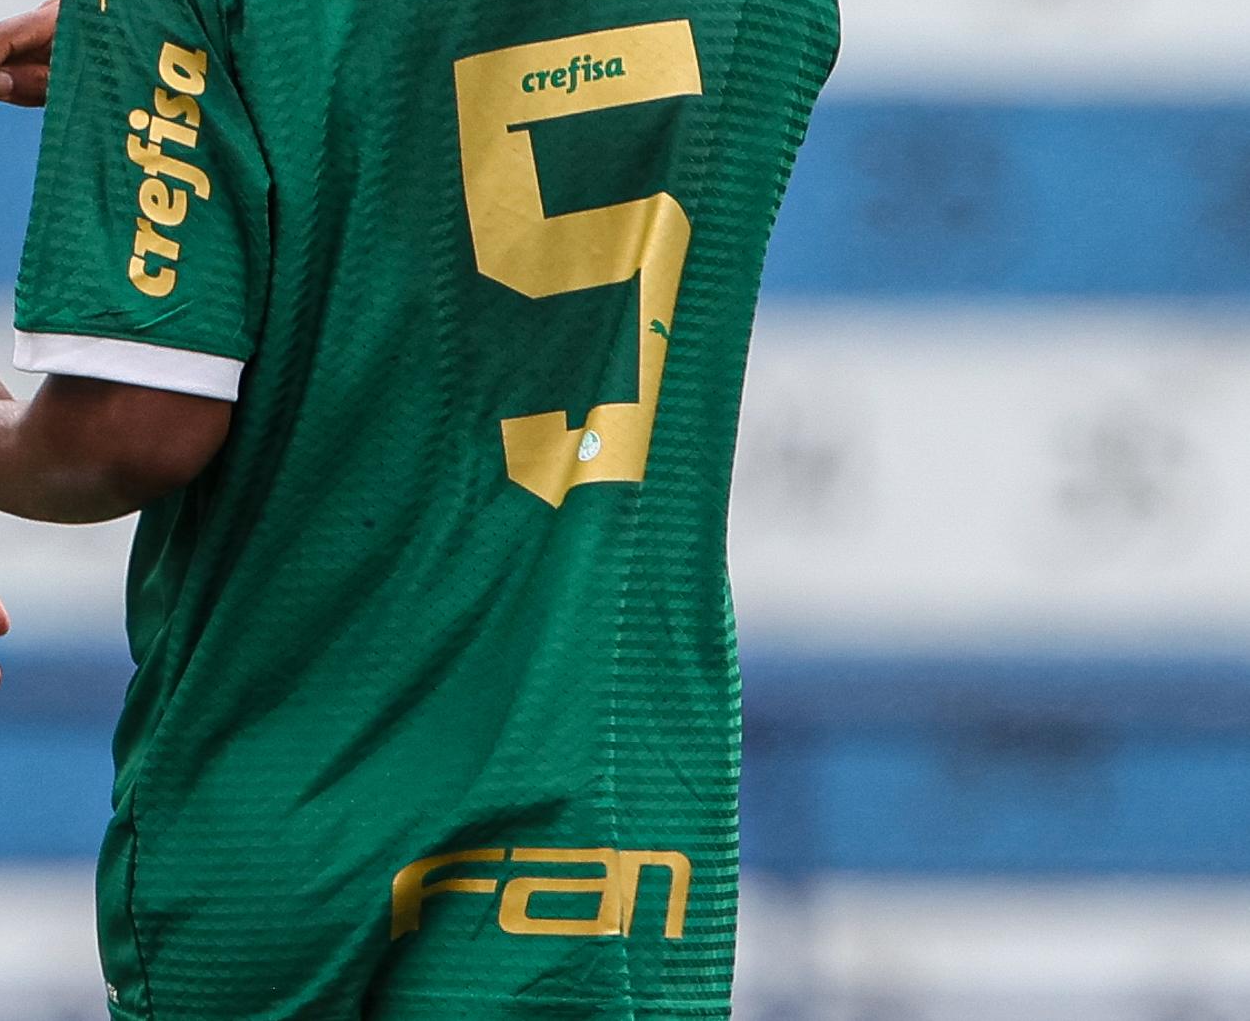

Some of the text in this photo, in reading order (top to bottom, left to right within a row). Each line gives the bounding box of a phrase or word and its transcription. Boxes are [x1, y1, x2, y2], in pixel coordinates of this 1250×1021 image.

[127, 42, 210, 297] crefisa
[521, 54, 626, 94] crefisa
[454, 19, 703, 509] 5
